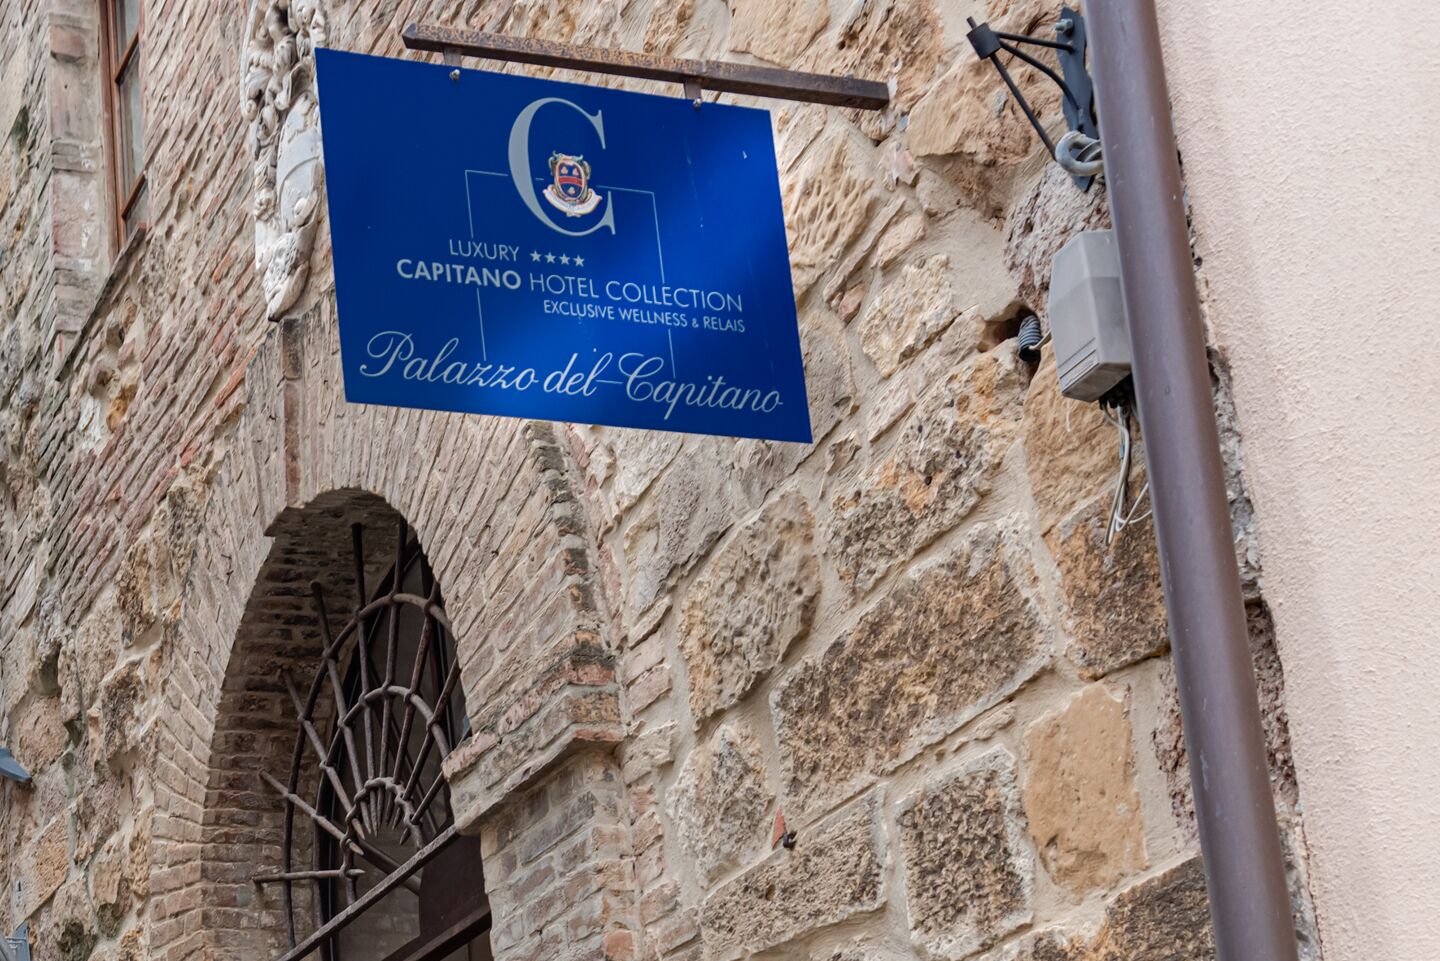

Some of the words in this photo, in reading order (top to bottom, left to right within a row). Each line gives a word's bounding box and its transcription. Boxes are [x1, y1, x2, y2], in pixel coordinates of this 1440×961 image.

[449, 238, 520, 262] LUXURY
[396, 258, 522, 290] CAPITANO
[529, 272, 600, 299] HOTEL
[605, 280, 743, 313] COLLECTION
[543, 299, 616, 320] EXCLUSIVE
[618, 307, 688, 328] WELLNESS
[691, 318, 699, 329] &
[702, 315, 746, 333] RELAIS
[359, 330, 539, 391] Palazzo
[542, 352, 614, 398] del
[618, 352, 784, 421] Capitano
